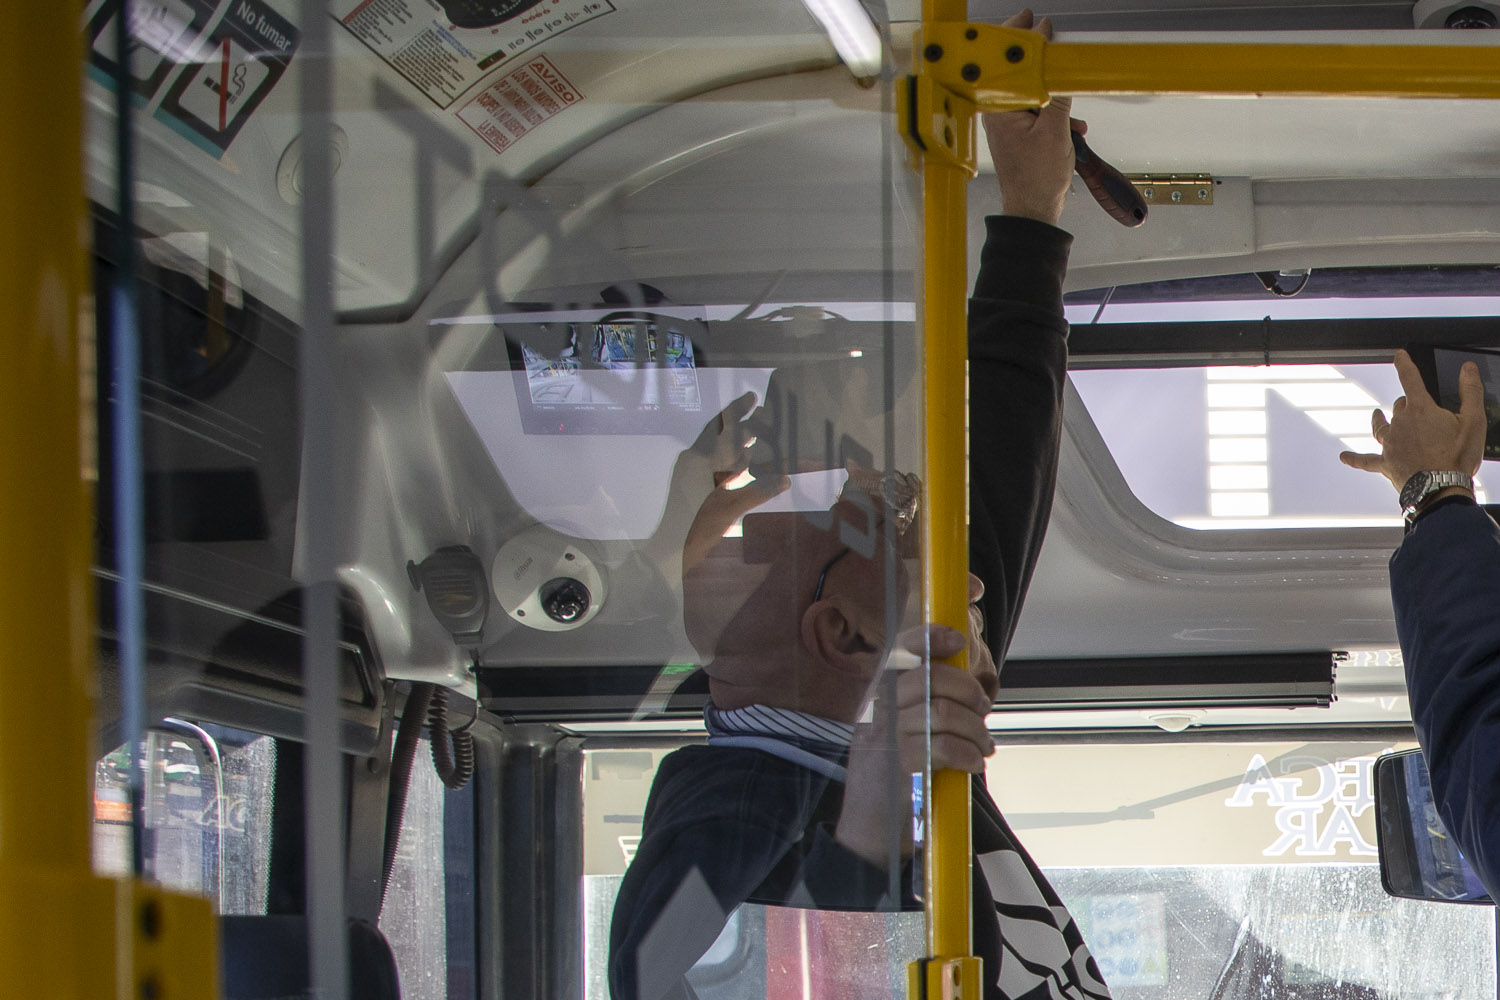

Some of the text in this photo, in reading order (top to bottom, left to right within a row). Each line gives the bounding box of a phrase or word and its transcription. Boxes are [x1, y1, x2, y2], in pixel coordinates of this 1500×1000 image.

[237, 1, 292, 50] No fumar
[531, 62, 575, 102] AVISO
